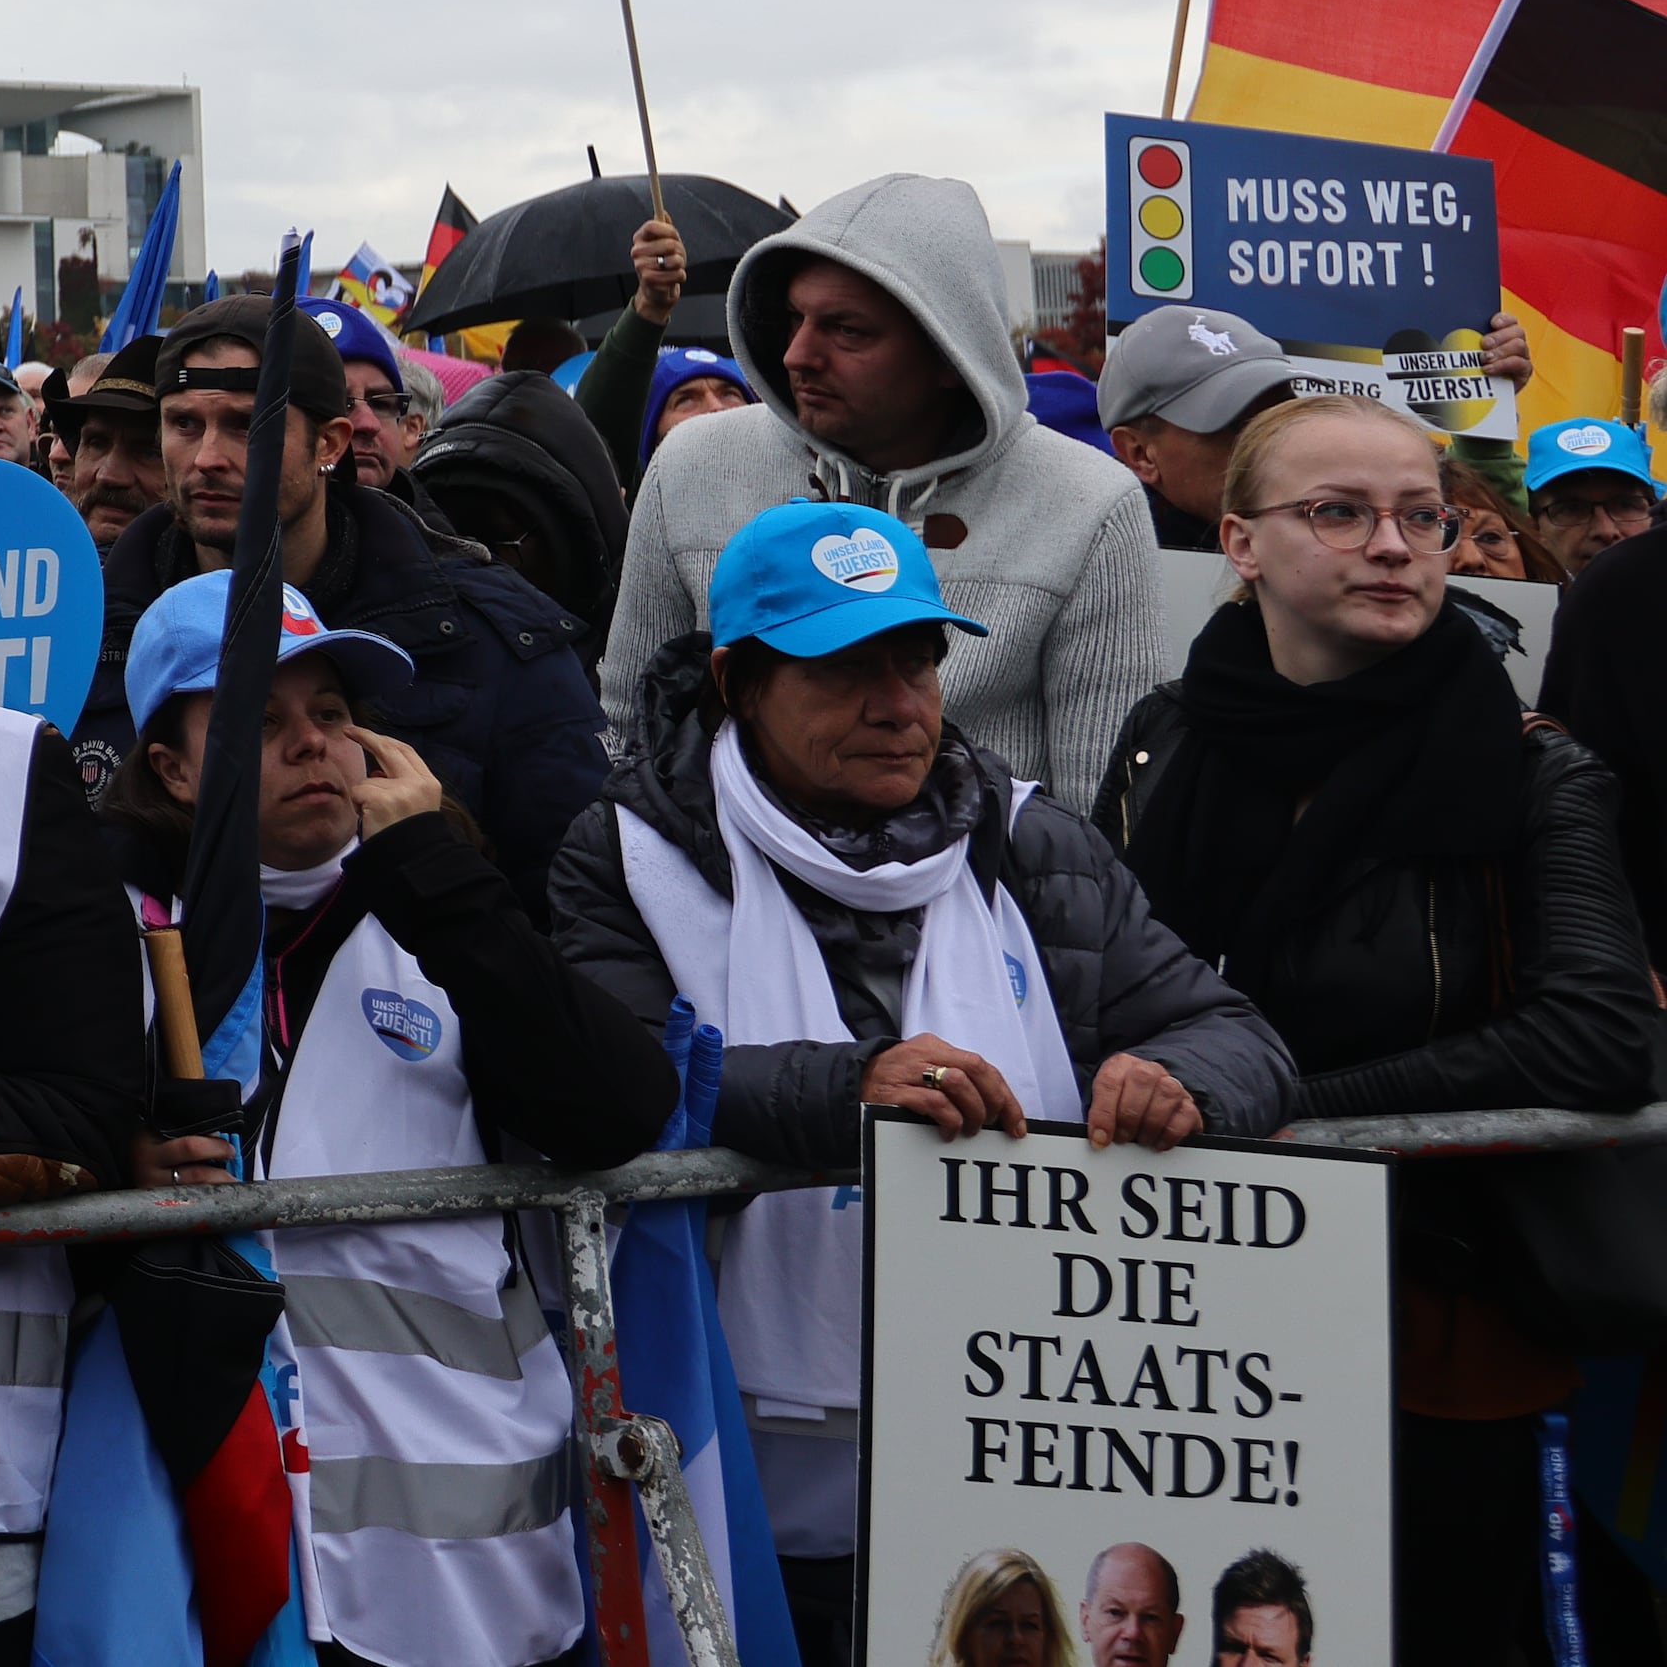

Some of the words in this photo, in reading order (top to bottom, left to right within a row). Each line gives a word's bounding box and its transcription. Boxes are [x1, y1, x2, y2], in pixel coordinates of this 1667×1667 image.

[1227, 178, 1347, 223] MUSS
[1363, 180, 1472, 233] WEG,
[1228, 240, 1403, 285] SOFORT
[1422, 243, 1435, 286] !
[1399, 353, 1447, 371] UNSER
[1404, 376, 1495, 402] ZUERST!
[823, 542, 859, 561] UNSER
[860, 539, 885, 551] LAND
[830, 551, 894, 579] ZUERST!
[371, 998, 407, 1016] UNSER
[407, 1008, 433, 1029] LAND
[372, 1010, 432, 1046] ZUERST!
[939, 1157, 1097, 1234] IHR
[1119, 1173, 1306, 1249] SEID
[1051, 1252, 1200, 1327] DIE
[964, 1330, 1304, 1419] STAATS-
[964, 1416, 1300, 1507] FEINDE!
